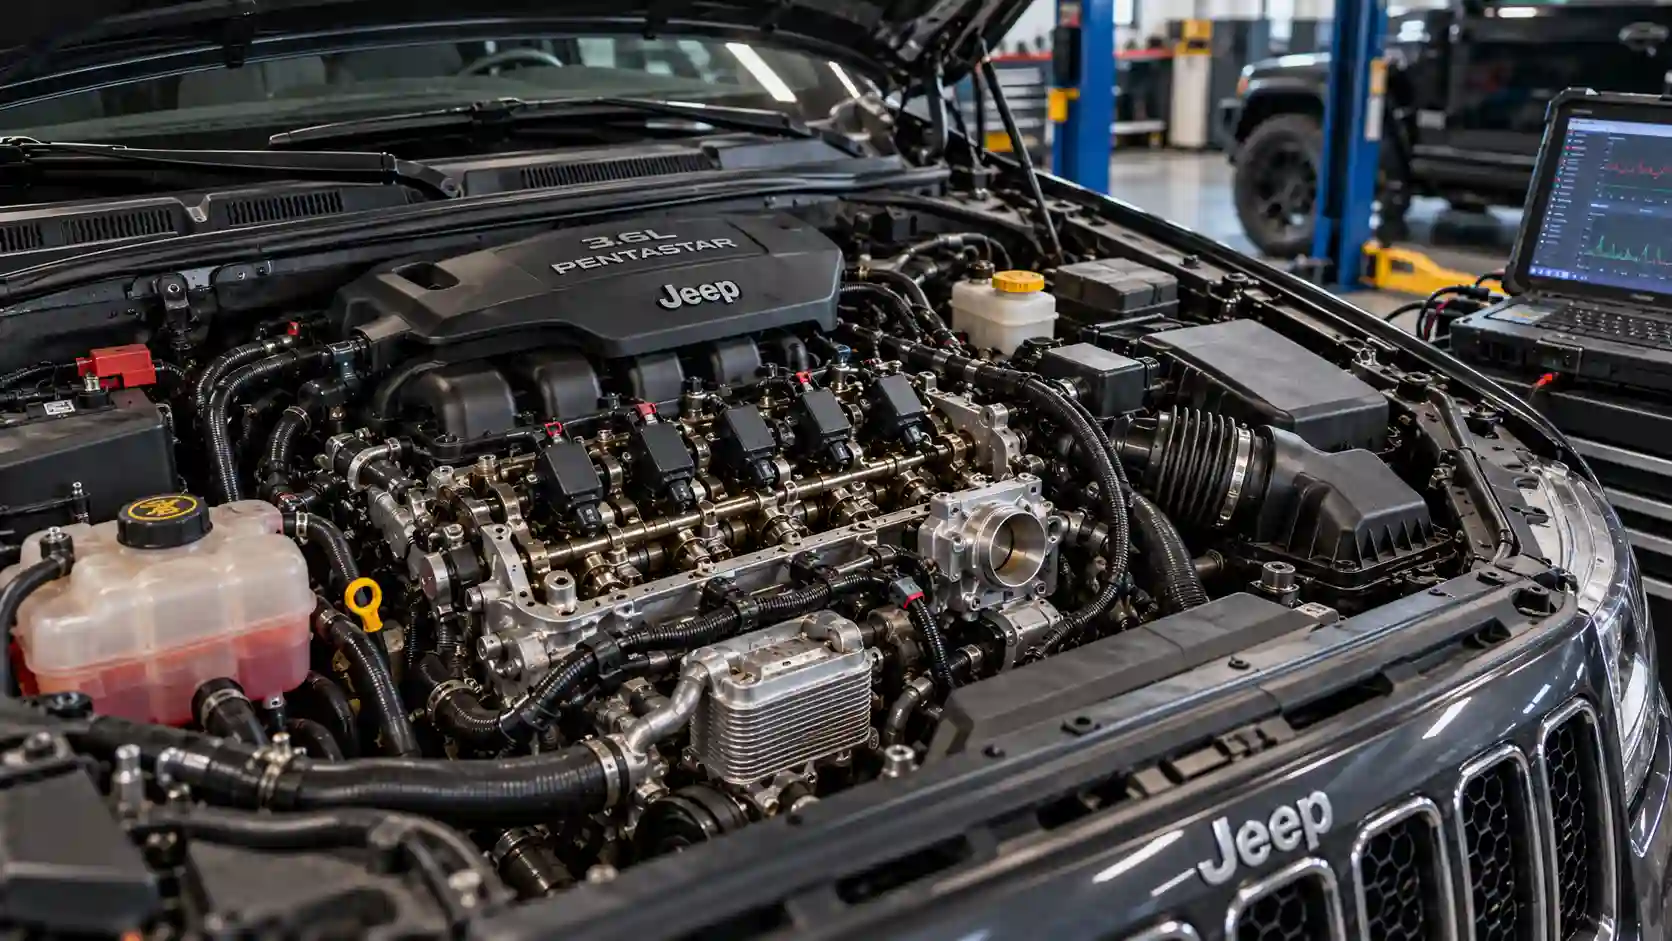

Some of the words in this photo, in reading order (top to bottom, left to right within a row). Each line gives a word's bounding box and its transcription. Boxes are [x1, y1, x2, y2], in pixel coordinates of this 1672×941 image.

[581, 229, 677, 250] 3.6L
[551, 238, 738, 275] PENTASTAR
[659, 280, 740, 309] Jeep
[1198, 790, 1333, 885] Jeep
